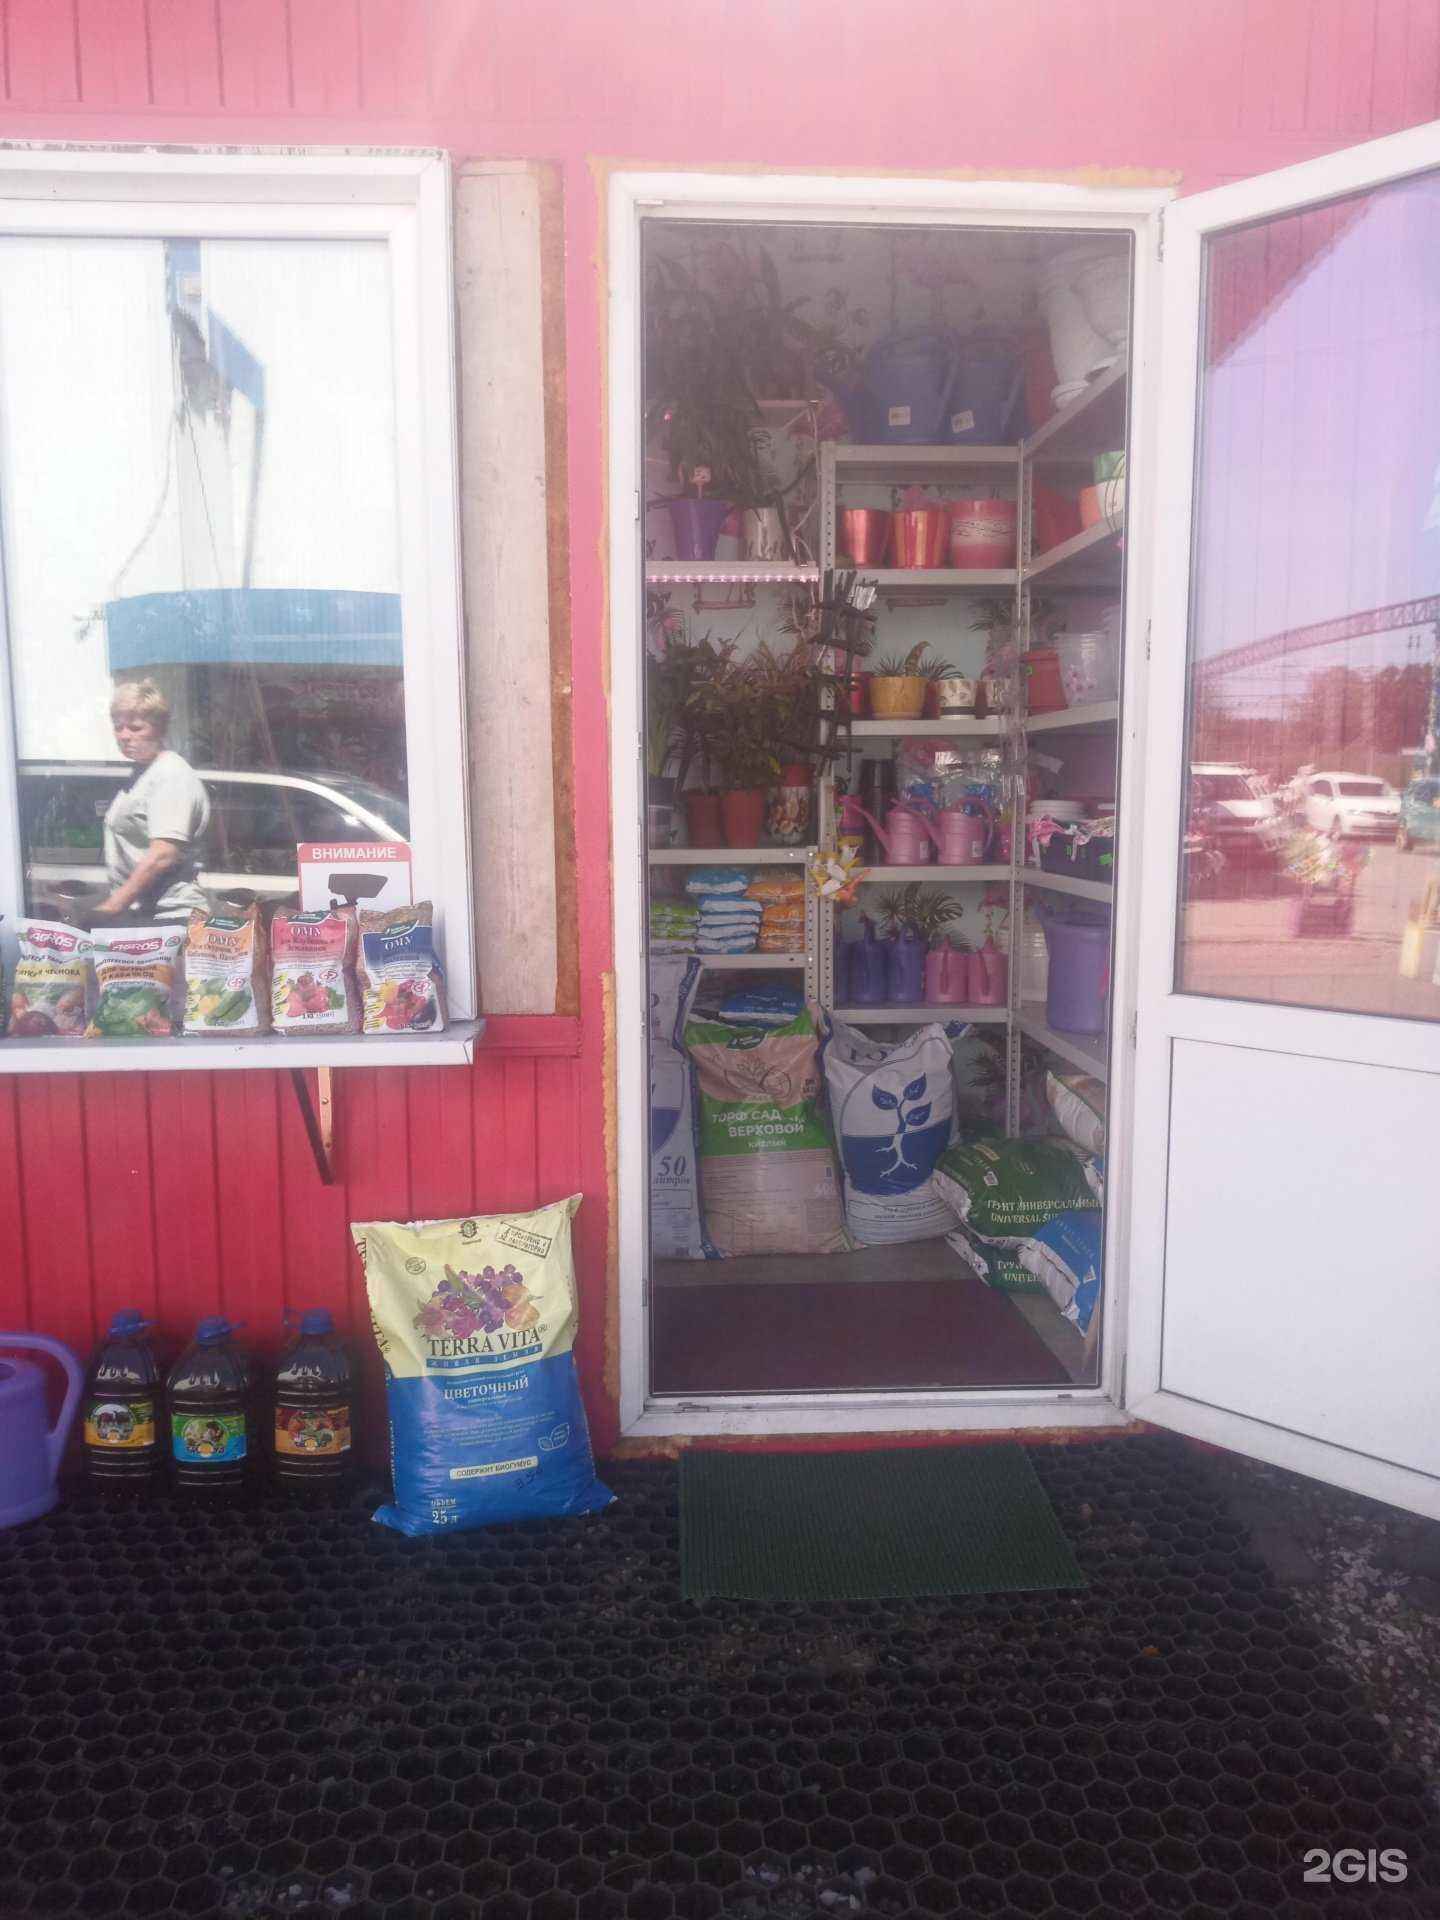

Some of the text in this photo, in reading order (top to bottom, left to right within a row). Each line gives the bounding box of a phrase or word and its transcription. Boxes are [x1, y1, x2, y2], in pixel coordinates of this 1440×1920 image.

[312, 847, 398, 860] ВНИМАНИЕ
[30, 931, 76, 948] AGROS
[111, 940, 161, 951] AGROS
[711, 1109, 782, 1123] ТОРФ САД
[728, 1123, 804, 1138] ВЕРХОВОЙ
[657, 1155, 687, 1177] 50
[991, 1212, 1042, 1224] UNIVERSAL
[427, 1335, 494, 1357] TERRA
[499, 1328, 541, 1350] VITA
[444, 1374, 529, 1401] ЦВЕТОЧНЫЙ
[456, 1459, 533, 1478] СОДЕРЖИТ БИОГУМУС
[432, 1510, 448, 1524] 25
